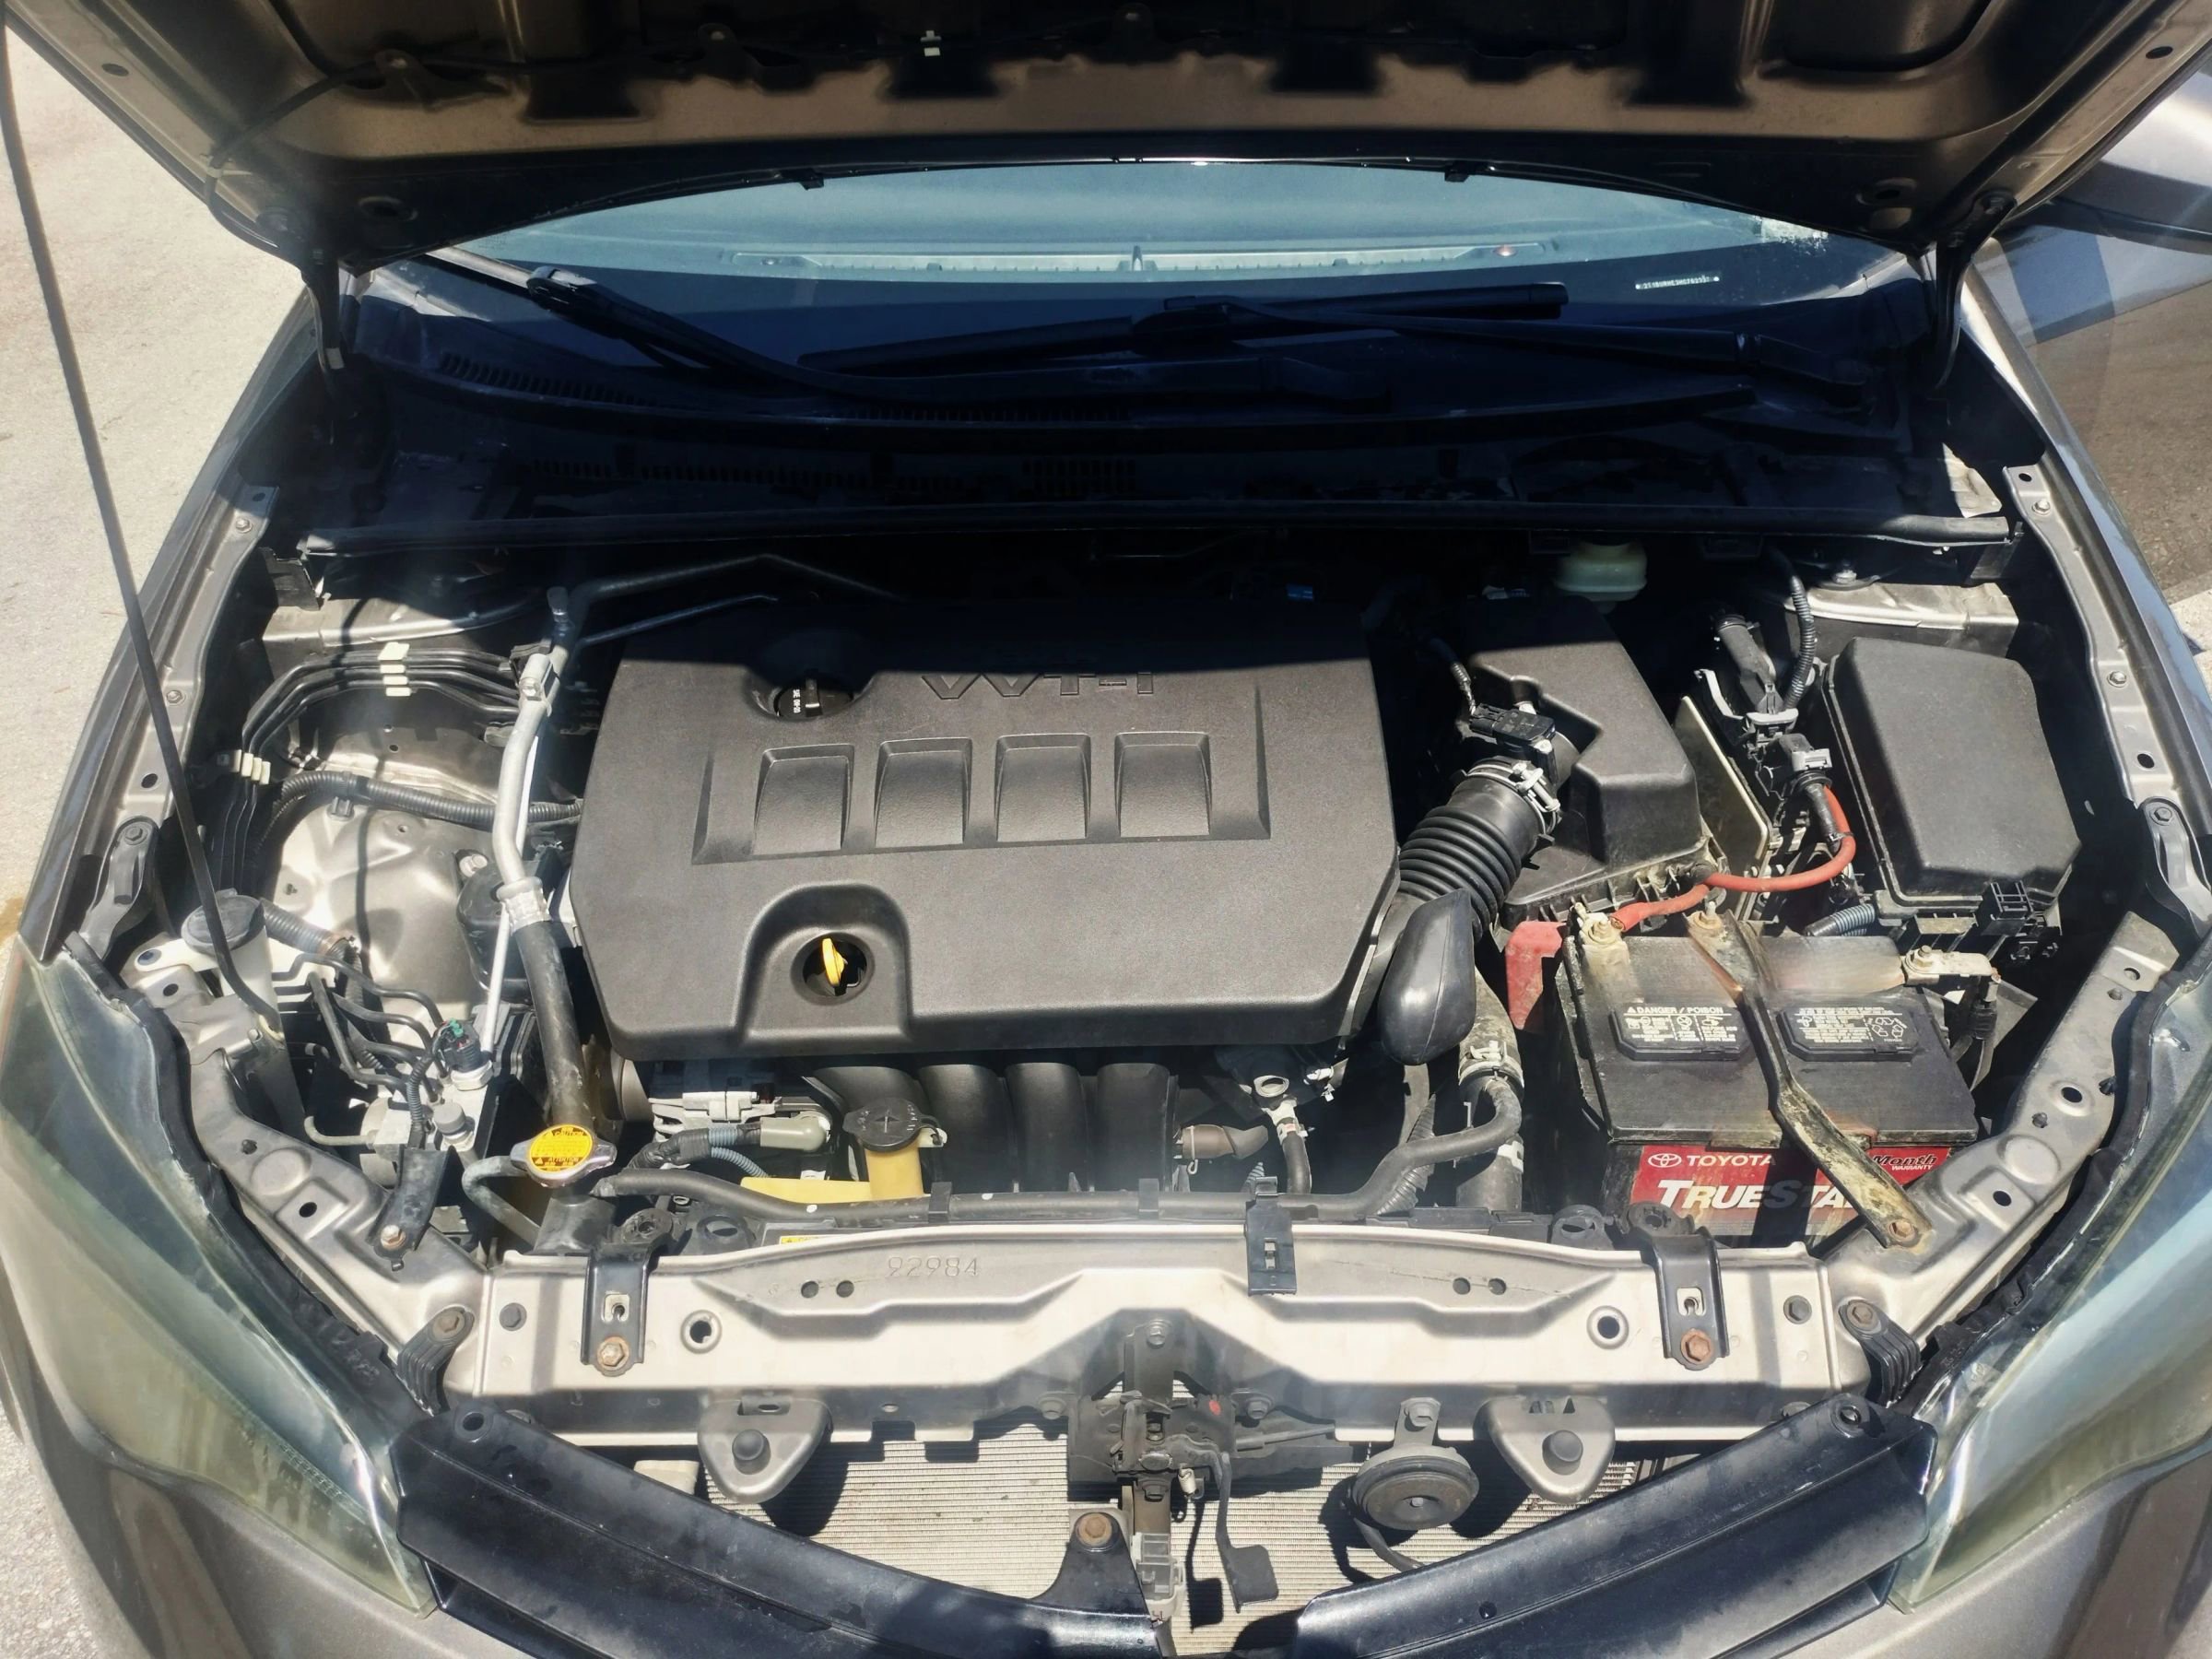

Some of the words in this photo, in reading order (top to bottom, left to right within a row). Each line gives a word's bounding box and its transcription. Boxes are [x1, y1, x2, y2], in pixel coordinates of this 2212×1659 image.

[1687, 1155, 1776, 1167] TOYOTA
[1873, 1154, 1937, 1166] Month
[1657, 1180, 1853, 1209] TRUESTA
